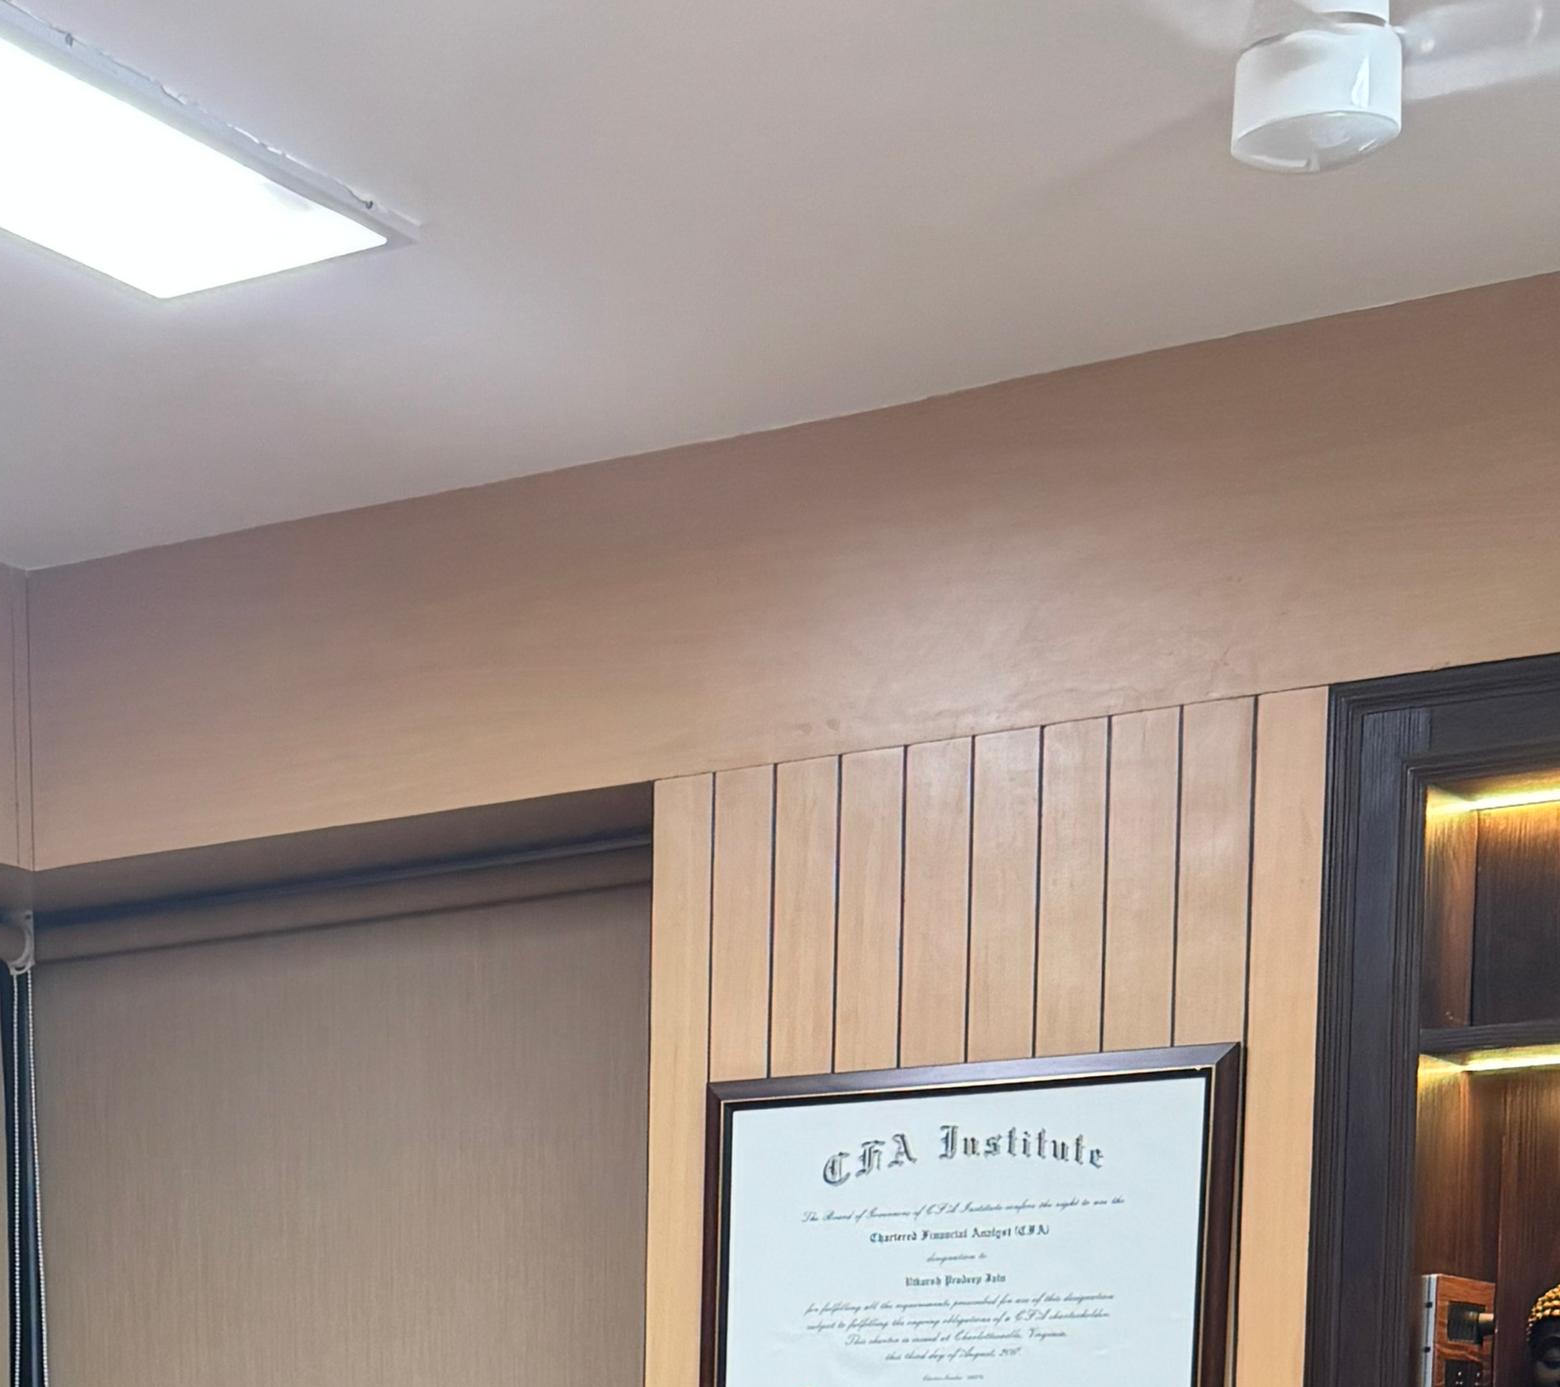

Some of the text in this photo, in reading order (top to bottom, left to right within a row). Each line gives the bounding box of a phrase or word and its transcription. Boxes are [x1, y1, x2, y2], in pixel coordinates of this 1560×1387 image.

[823, 1125, 1104, 1187] CFA Institute
[1112, 1195, 1125, 1205] the
[869, 1224, 1050, 1243] Chartered Financial Analyst (CFA)
[926, 1252, 976, 1266] designation
